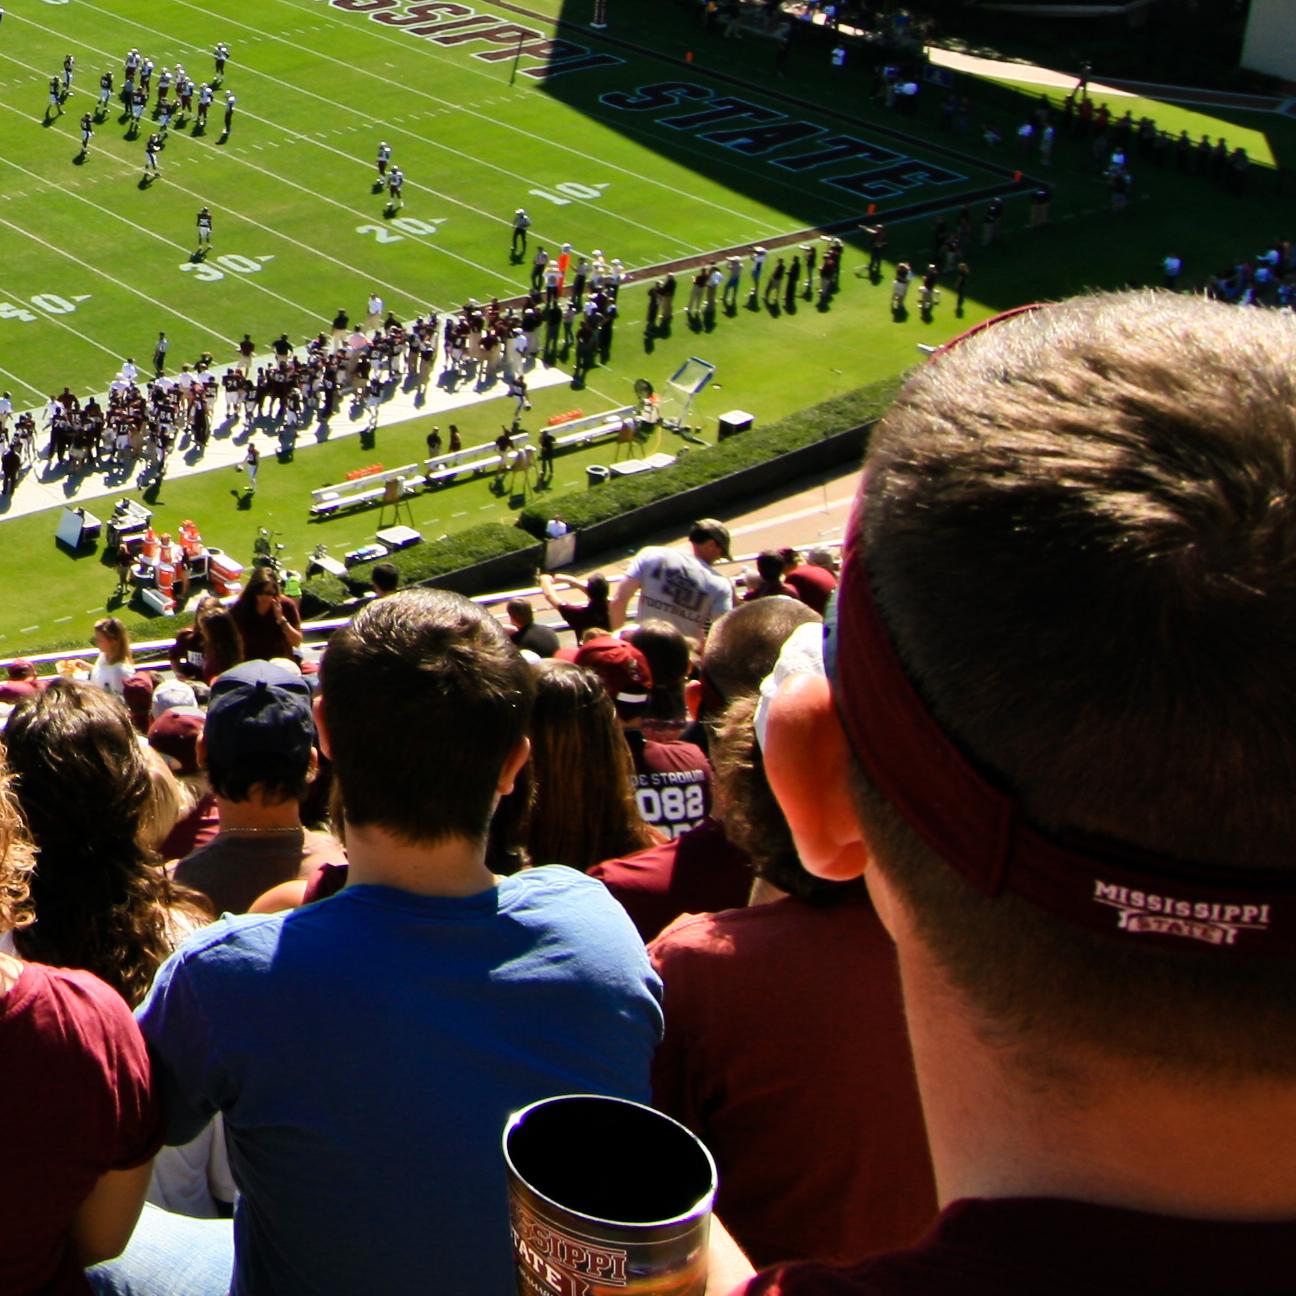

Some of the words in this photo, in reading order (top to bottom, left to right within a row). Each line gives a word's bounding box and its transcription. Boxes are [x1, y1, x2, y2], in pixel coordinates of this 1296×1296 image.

[598, 81, 969, 200] STATE
[528, 181, 602, 206] 10
[356, 216, 439, 244] 20
[179, 253, 263, 282] 30
[1094, 879, 1271, 924] MISSISSIPPI
